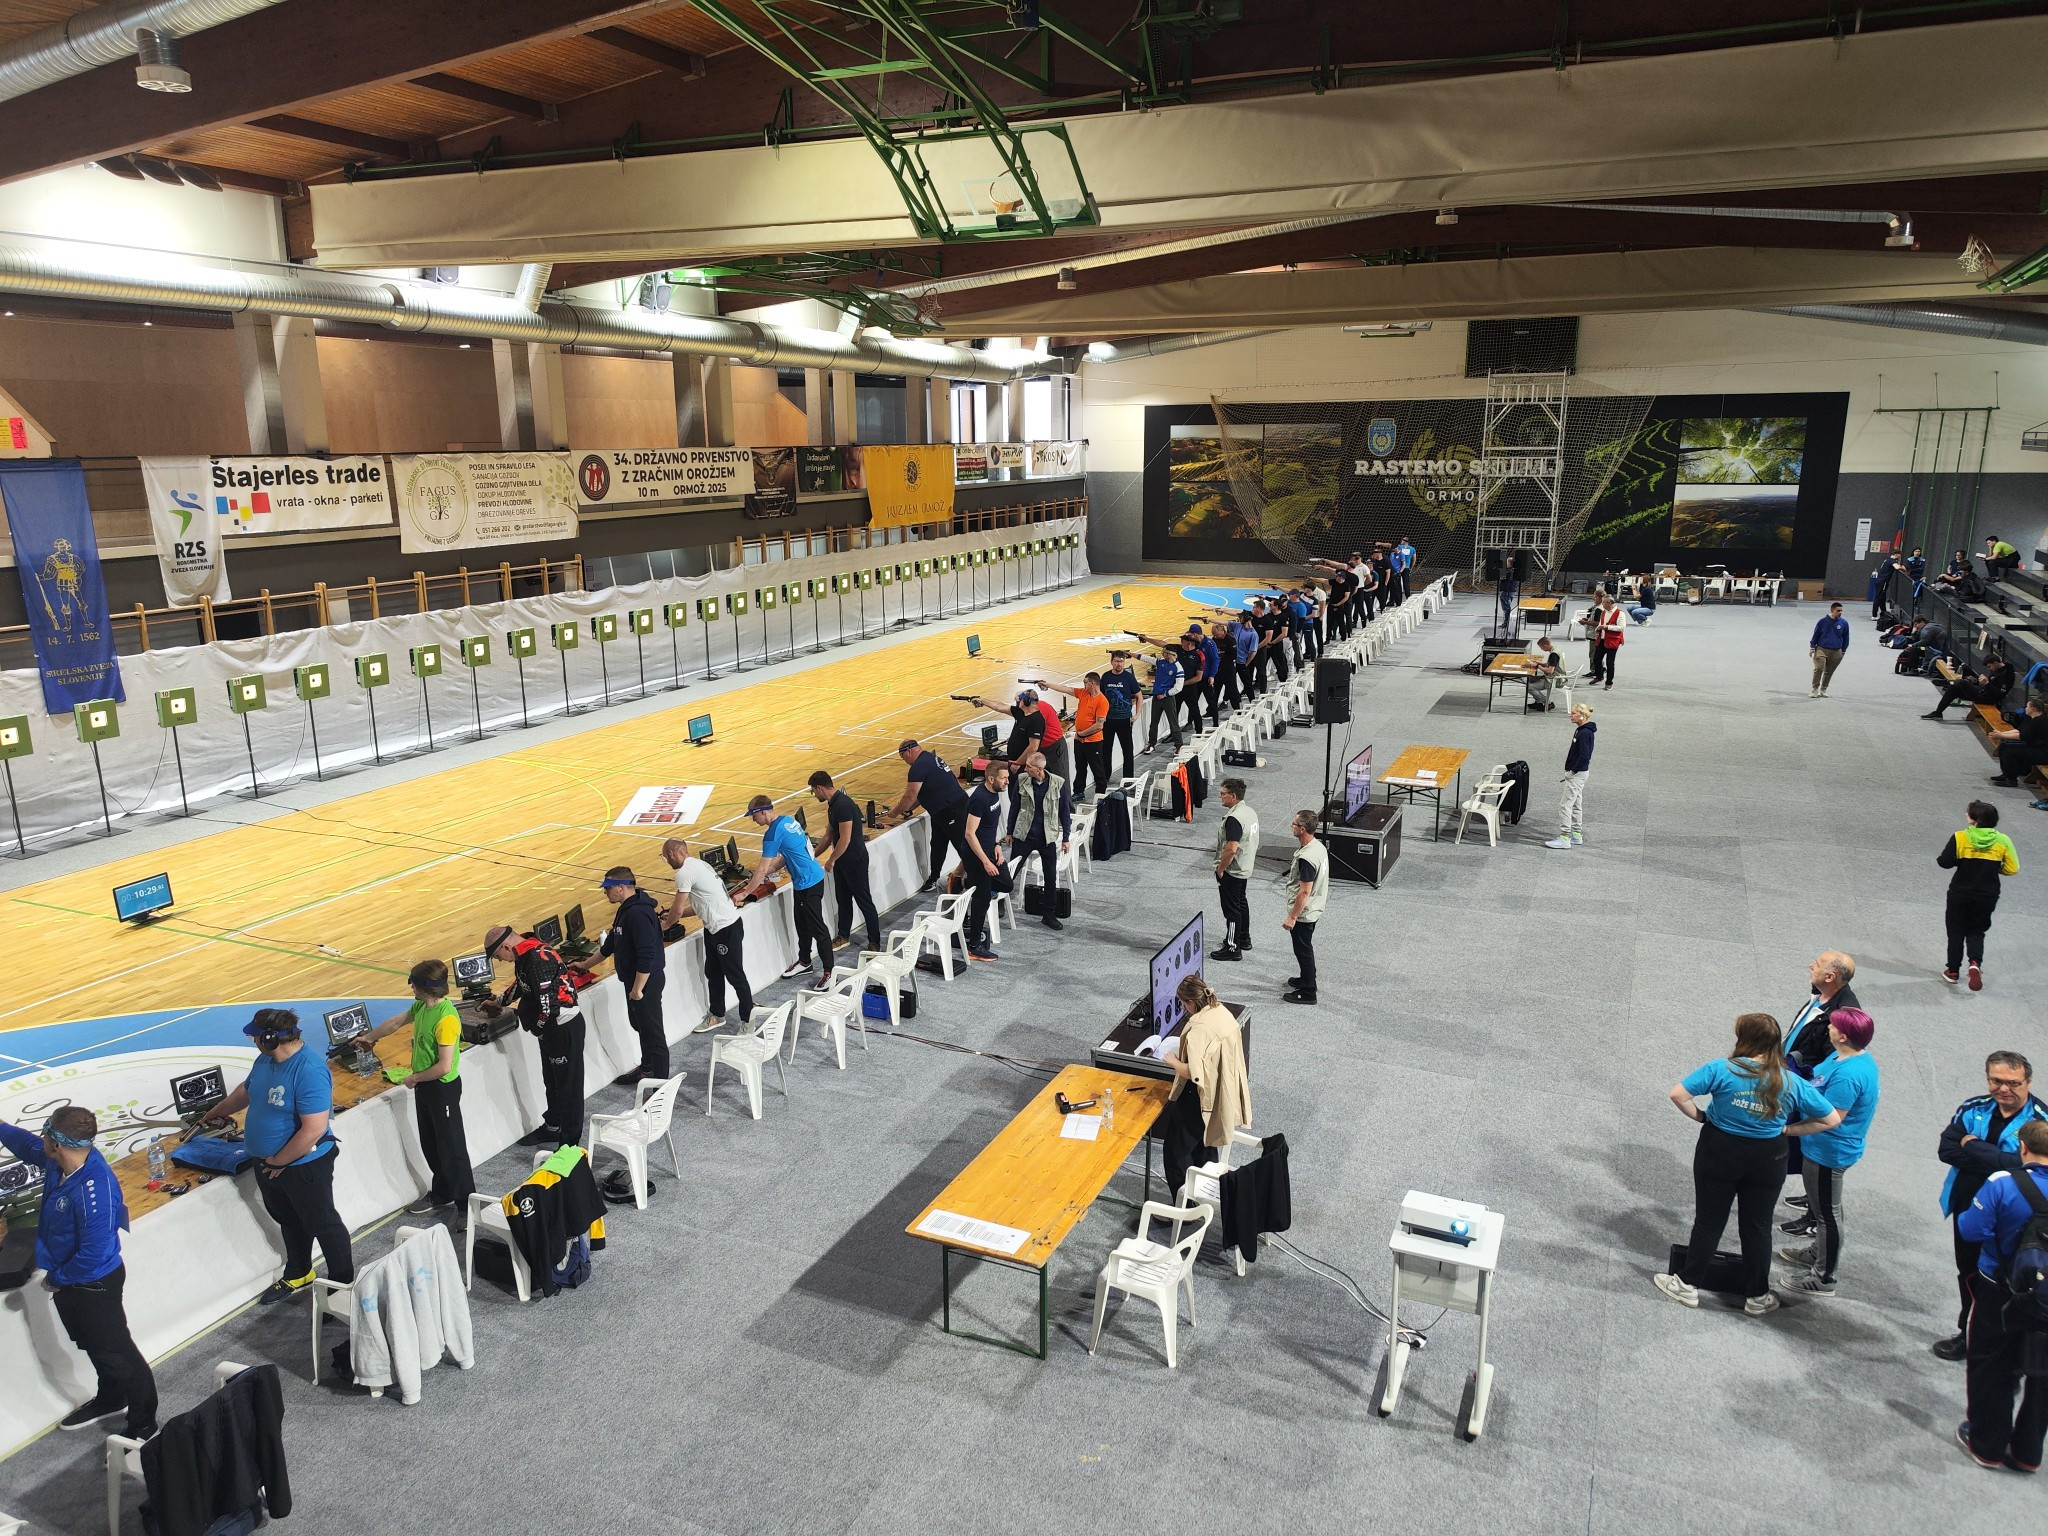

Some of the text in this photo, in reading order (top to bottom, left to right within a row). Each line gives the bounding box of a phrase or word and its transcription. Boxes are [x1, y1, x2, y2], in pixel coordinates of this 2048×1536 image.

[613, 450, 750, 466] 34. DRŽAVNO PRVENSTVO
[468, 463, 487, 471] POSEK
[496, 462, 522, 470] SPRAVILO
[523, 462, 536, 470] LESA
[622, 464, 736, 483] Z ZRAČNIM OROŽJEM
[1354, 459, 1462, 475] RASTEMO
[211, 460, 381, 491] Štajerles trade
[528, 479, 542, 487] DELA
[638, 482, 727, 498] 10 m ORMOŽ 2025
[420, 486, 457, 497] FAGUS
[276, 492, 383, 507] vrata okna parketi
[478, 498, 532, 508] PREVOZI HLODOVINE
[516, 507, 536, 516] DREVES
[174, 540, 207, 559] RZS
[176, 558, 208, 566] ROKOMETNA
[189, 564, 215, 572] SLOVENIJE
[48, 631, 100, 645] 14. 7. 1562
[57, 672, 106, 686] SLOVENIJE
[1731, 1099, 1749, 1109] JOŽE
